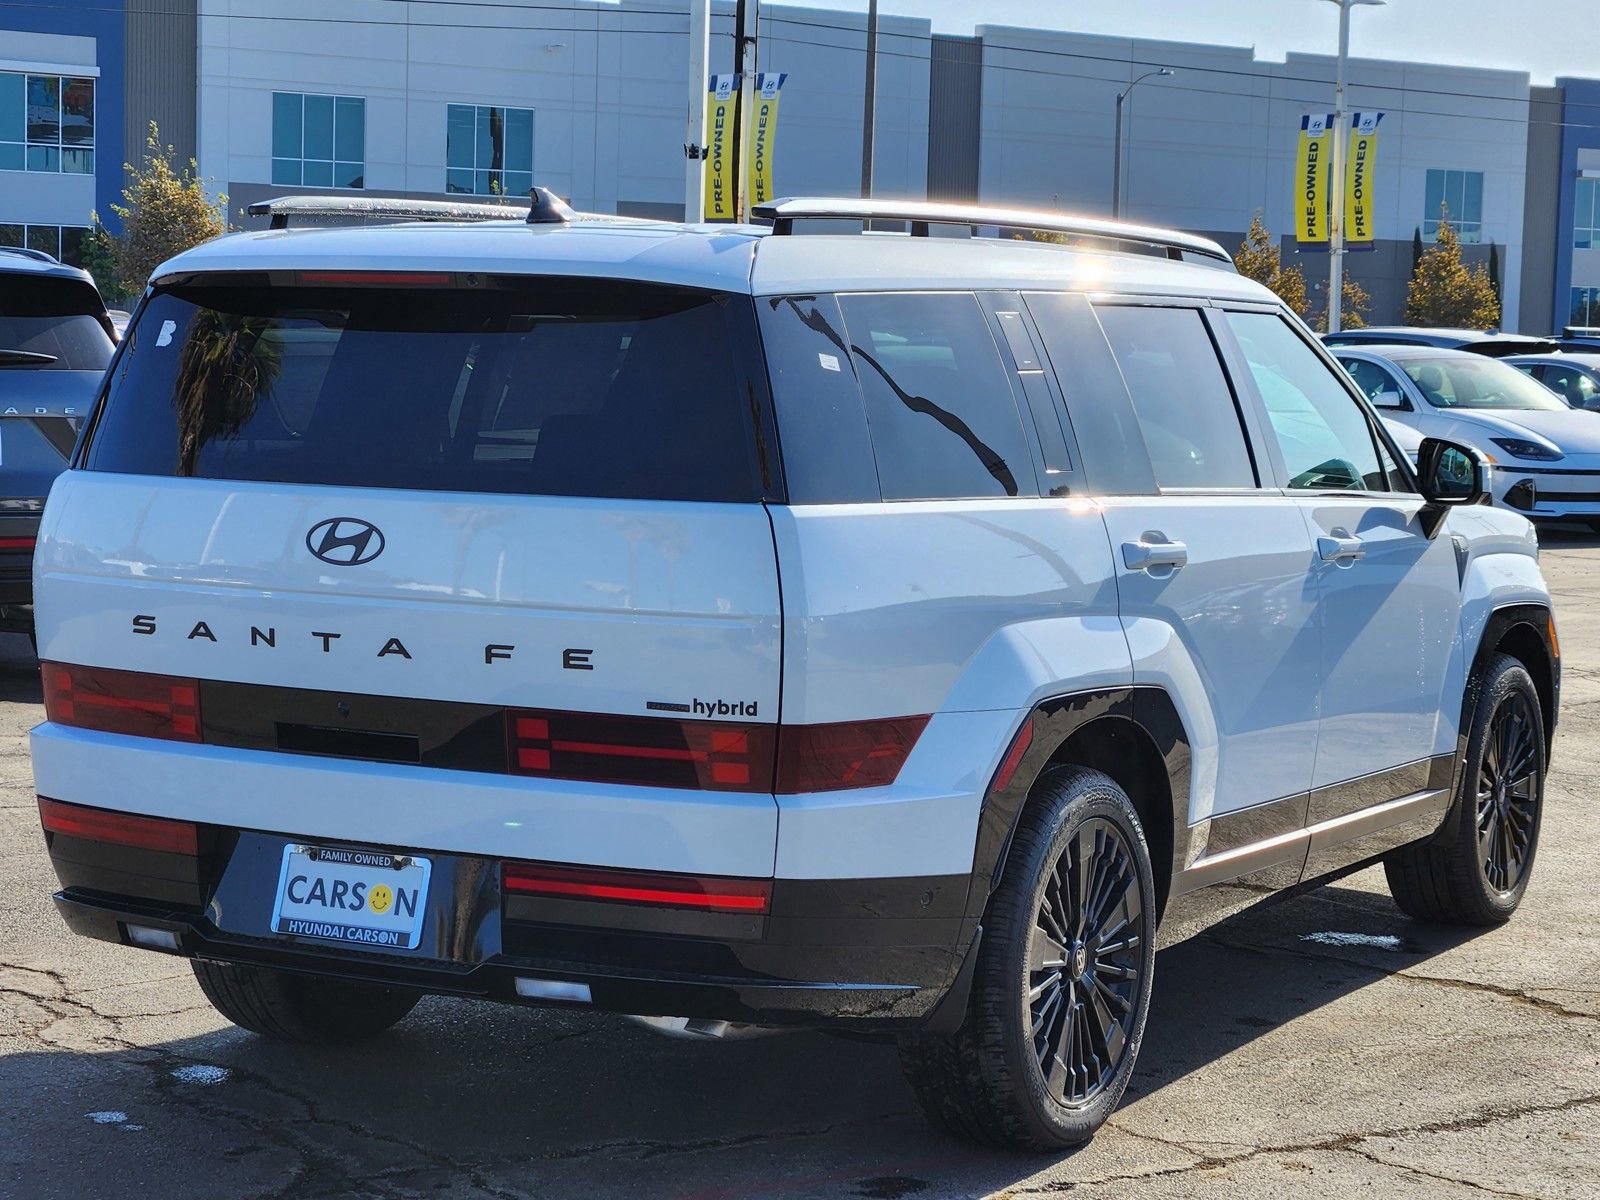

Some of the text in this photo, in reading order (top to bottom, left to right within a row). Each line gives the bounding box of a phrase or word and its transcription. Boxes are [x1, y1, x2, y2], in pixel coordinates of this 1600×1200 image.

[713, 105, 725, 214] PRE-OWNED
[755, 104, 769, 202] RE-OWNED
[1306, 142, 1319, 237] PRE-OWNED
[1354, 140, 1367, 237] PRE-OWNED
[132, 614, 594, 671] SANTA FE
[693, 698, 758, 718] hybrid
[320, 850, 391, 867] FAMILY OWNED
[288, 920, 345, 938] HYUNDAI
